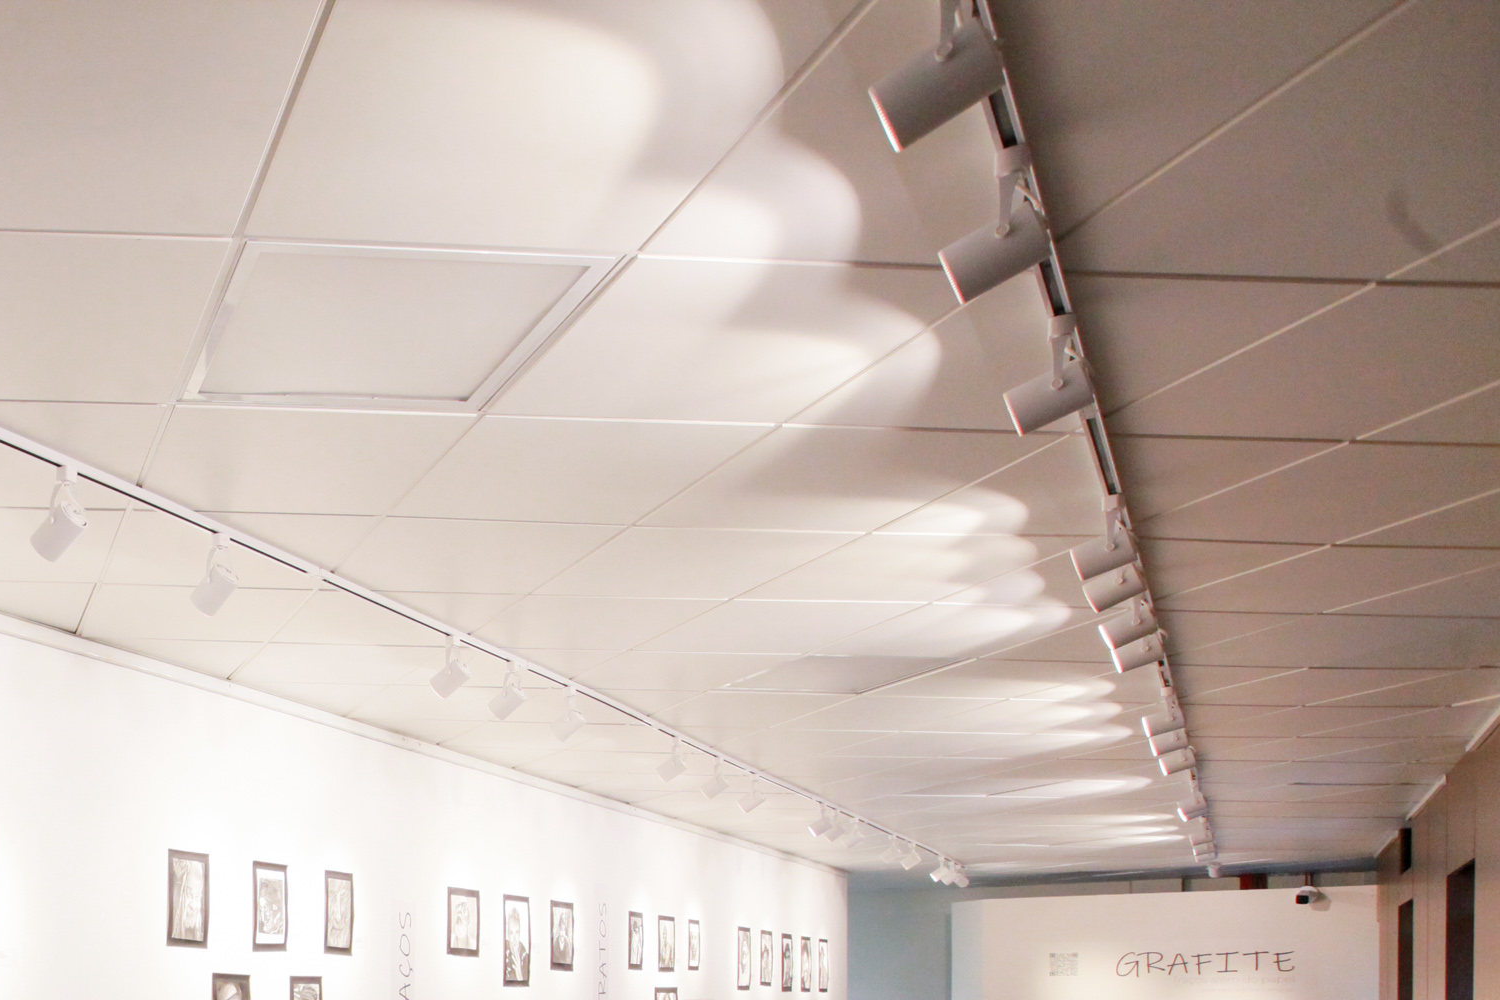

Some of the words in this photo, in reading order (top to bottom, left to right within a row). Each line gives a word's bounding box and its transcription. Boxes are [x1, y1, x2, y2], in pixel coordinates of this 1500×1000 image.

[1115, 951, 1296, 978] GRAFITE
[1242, 975, 1258, 984] do
[1261, 975, 1296, 985] papel
